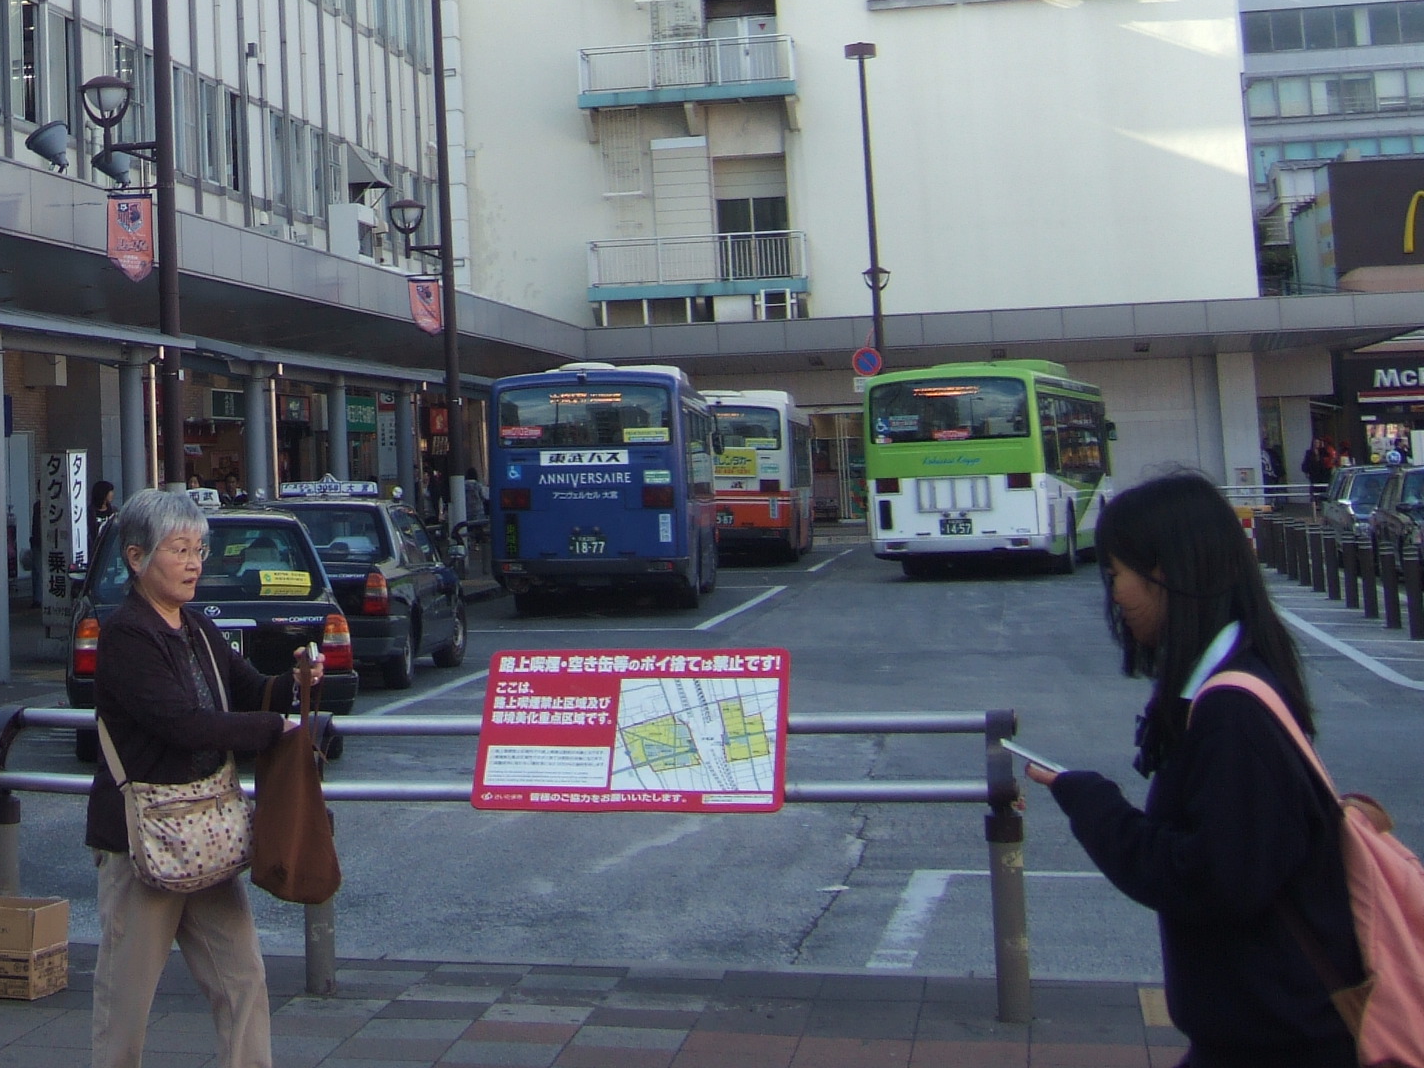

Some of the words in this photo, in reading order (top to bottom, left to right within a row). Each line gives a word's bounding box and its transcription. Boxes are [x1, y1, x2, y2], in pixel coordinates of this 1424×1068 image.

[548, 452, 621, 464] 東武バス
[539, 472, 632, 488] ANNIVERSAIRE
[602, 491, 618, 500] 大宮
[46, 454, 67, 599] タクシー乗場
[575, 540, 606, 554] 18-77
[495, 681, 535, 694] ここは、
